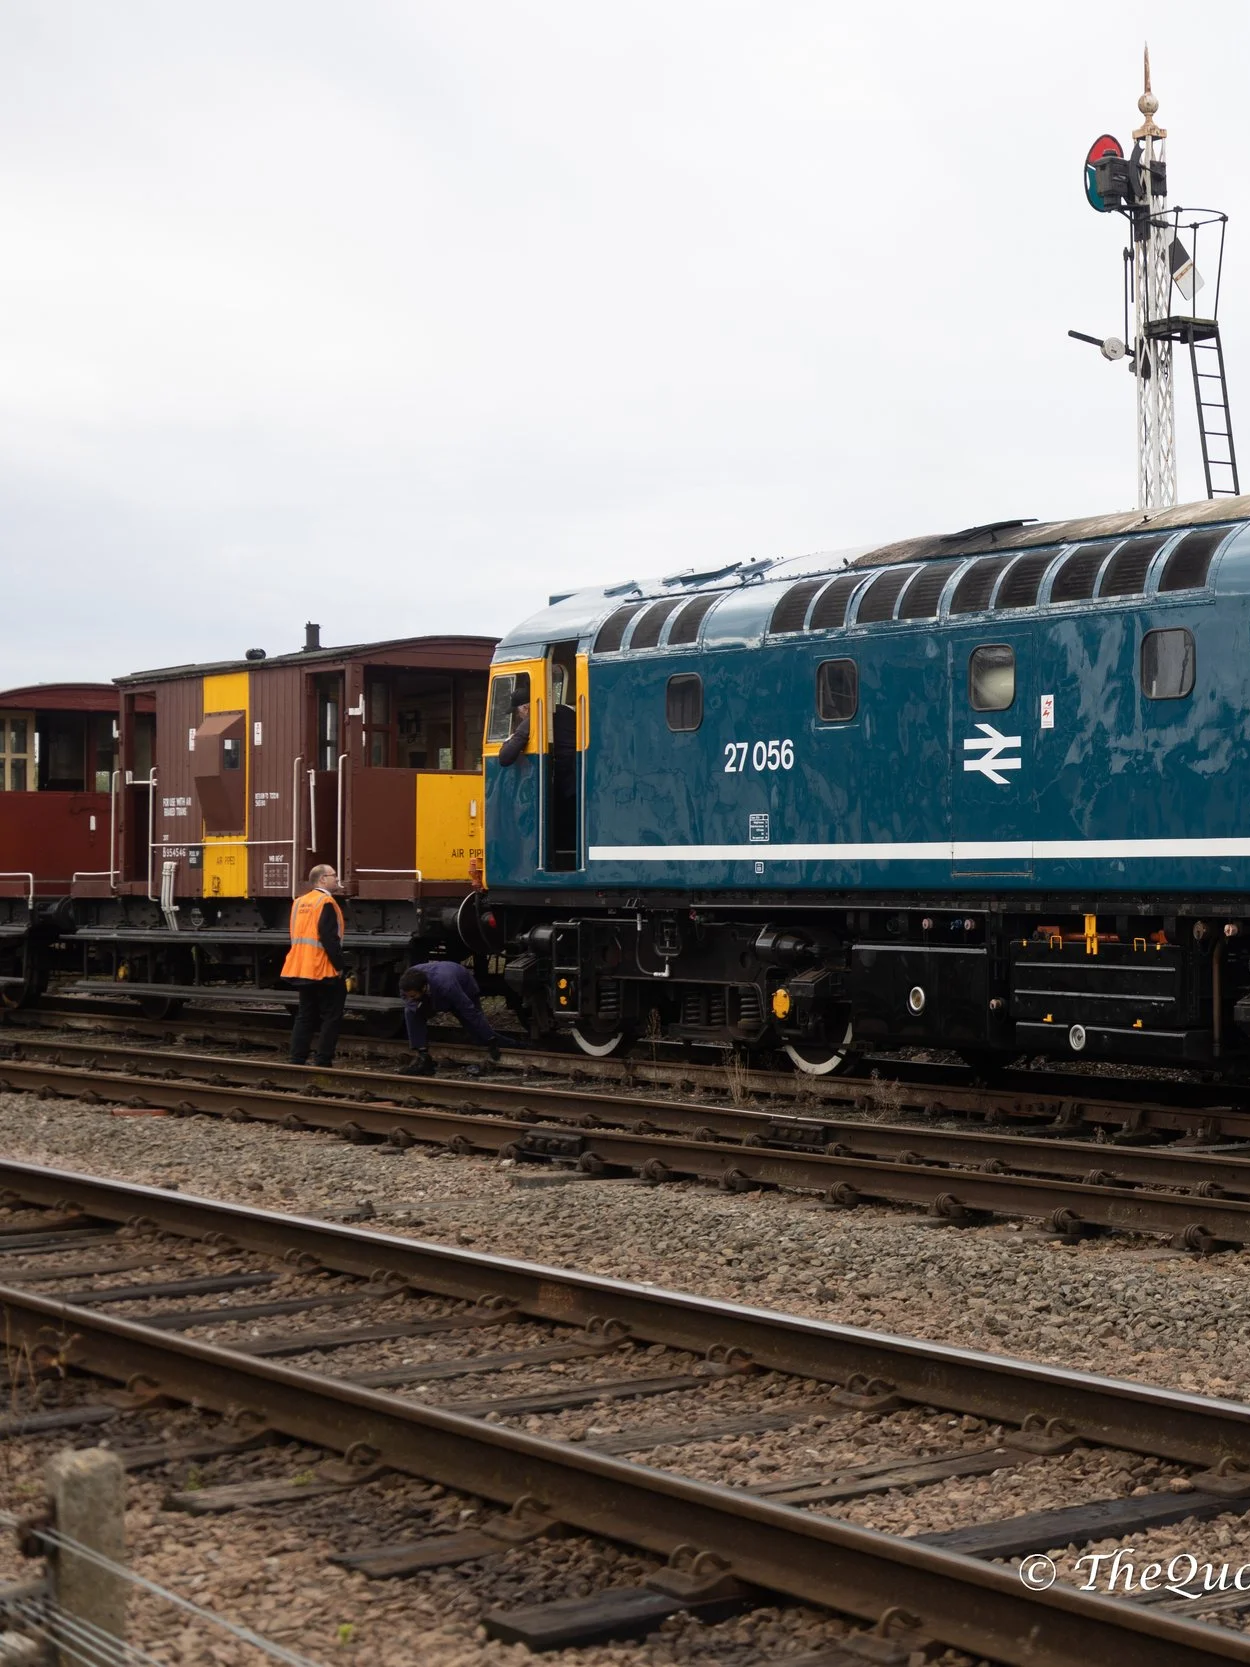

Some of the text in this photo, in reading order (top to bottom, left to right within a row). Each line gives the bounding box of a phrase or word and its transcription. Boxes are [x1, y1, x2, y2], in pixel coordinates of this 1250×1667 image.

[724, 739, 794, 773] 27 056
[451, 848, 465, 858] AIR
